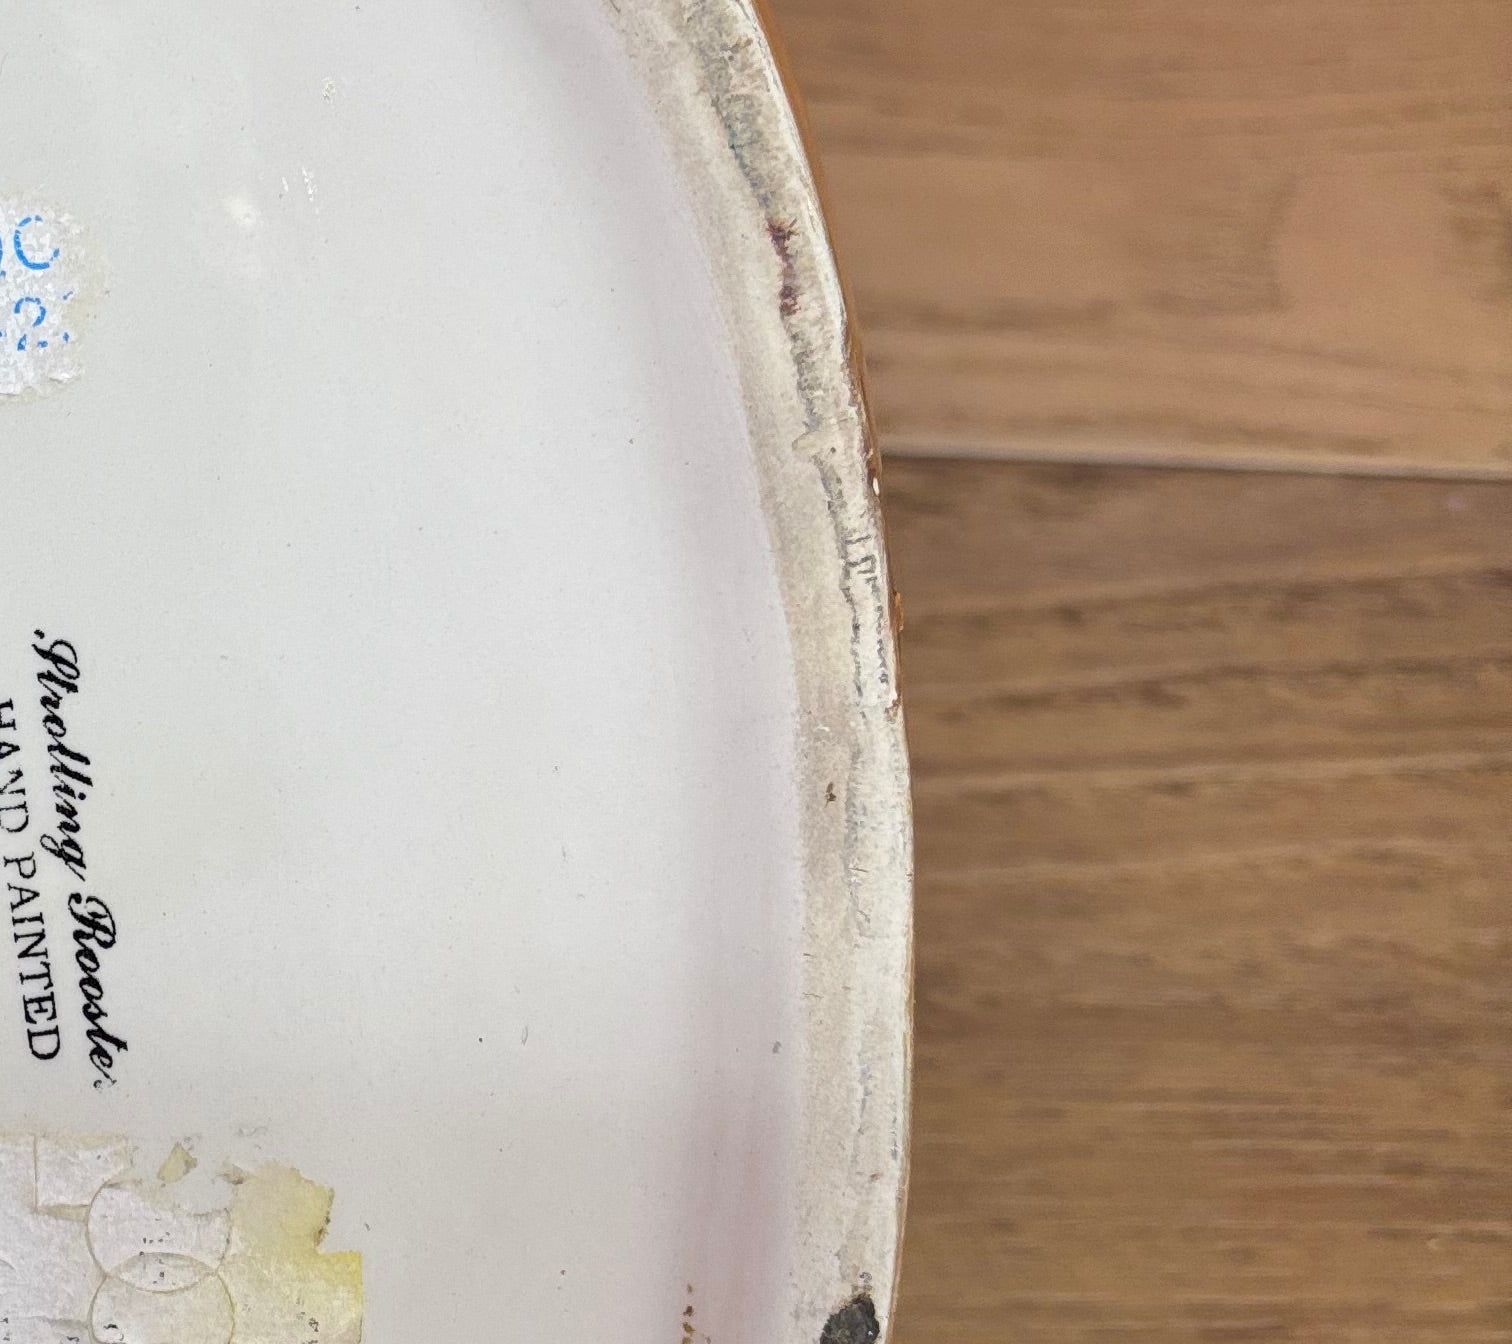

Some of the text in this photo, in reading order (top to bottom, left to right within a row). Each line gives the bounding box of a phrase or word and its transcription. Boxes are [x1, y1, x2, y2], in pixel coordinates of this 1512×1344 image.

[2, 850, 61, 1061] PAINTED
[31, 629, 129, 1089] Strolling Rooste
